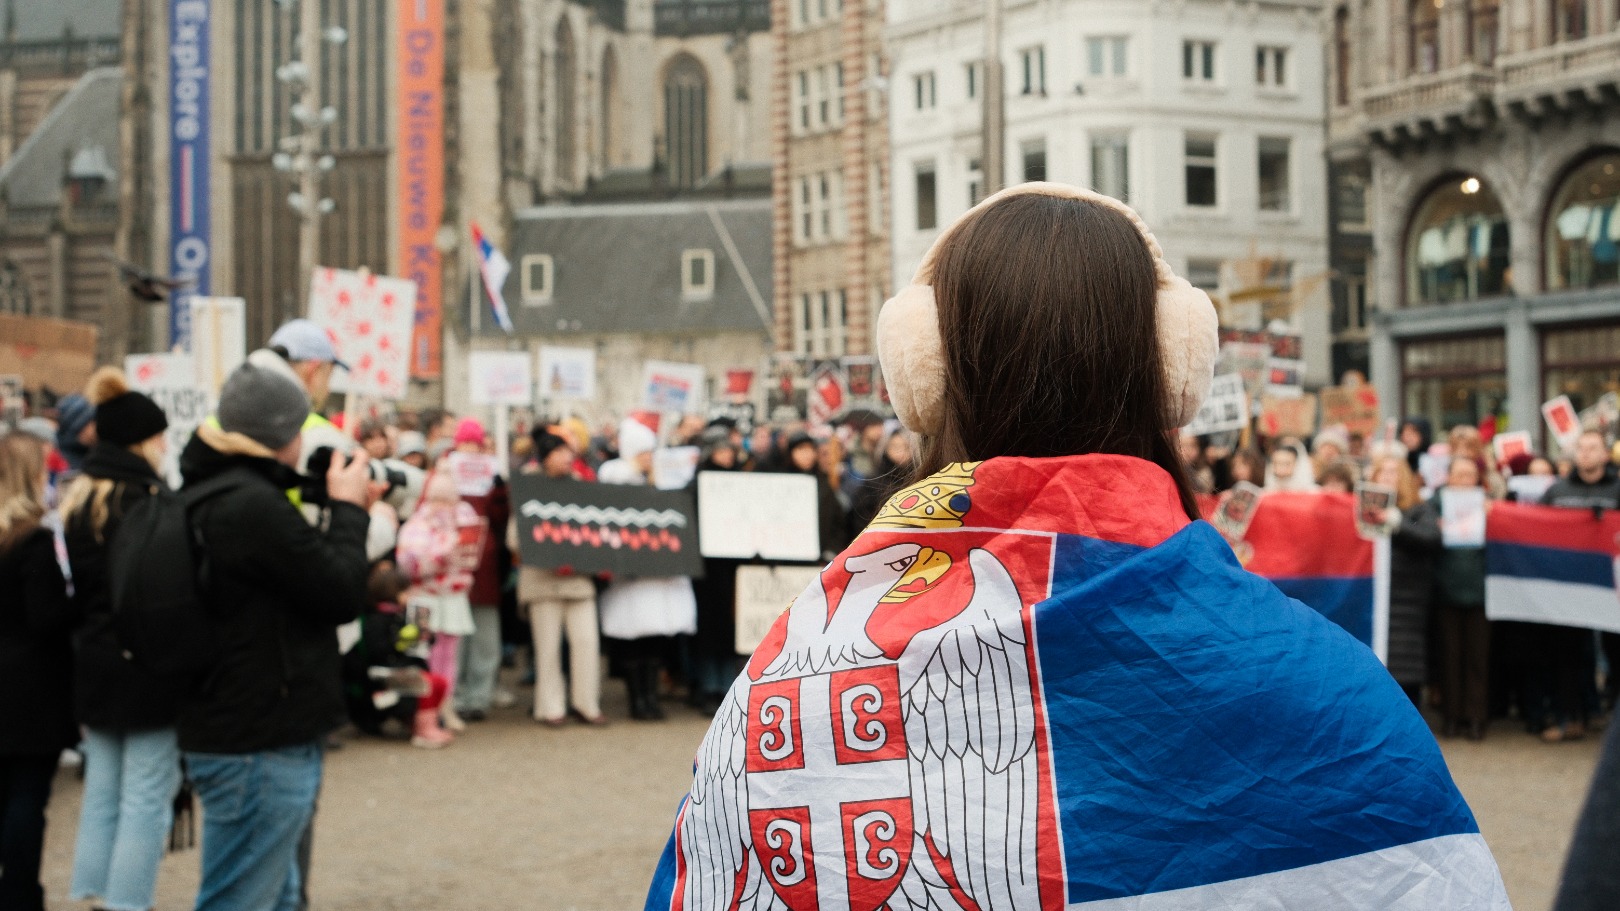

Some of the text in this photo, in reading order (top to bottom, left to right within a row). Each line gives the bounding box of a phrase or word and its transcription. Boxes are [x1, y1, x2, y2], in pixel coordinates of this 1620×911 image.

[172, 1, 207, 140] Explore
[406, 28, 434, 77] De
[407, 91, 434, 230] Nieuwe
